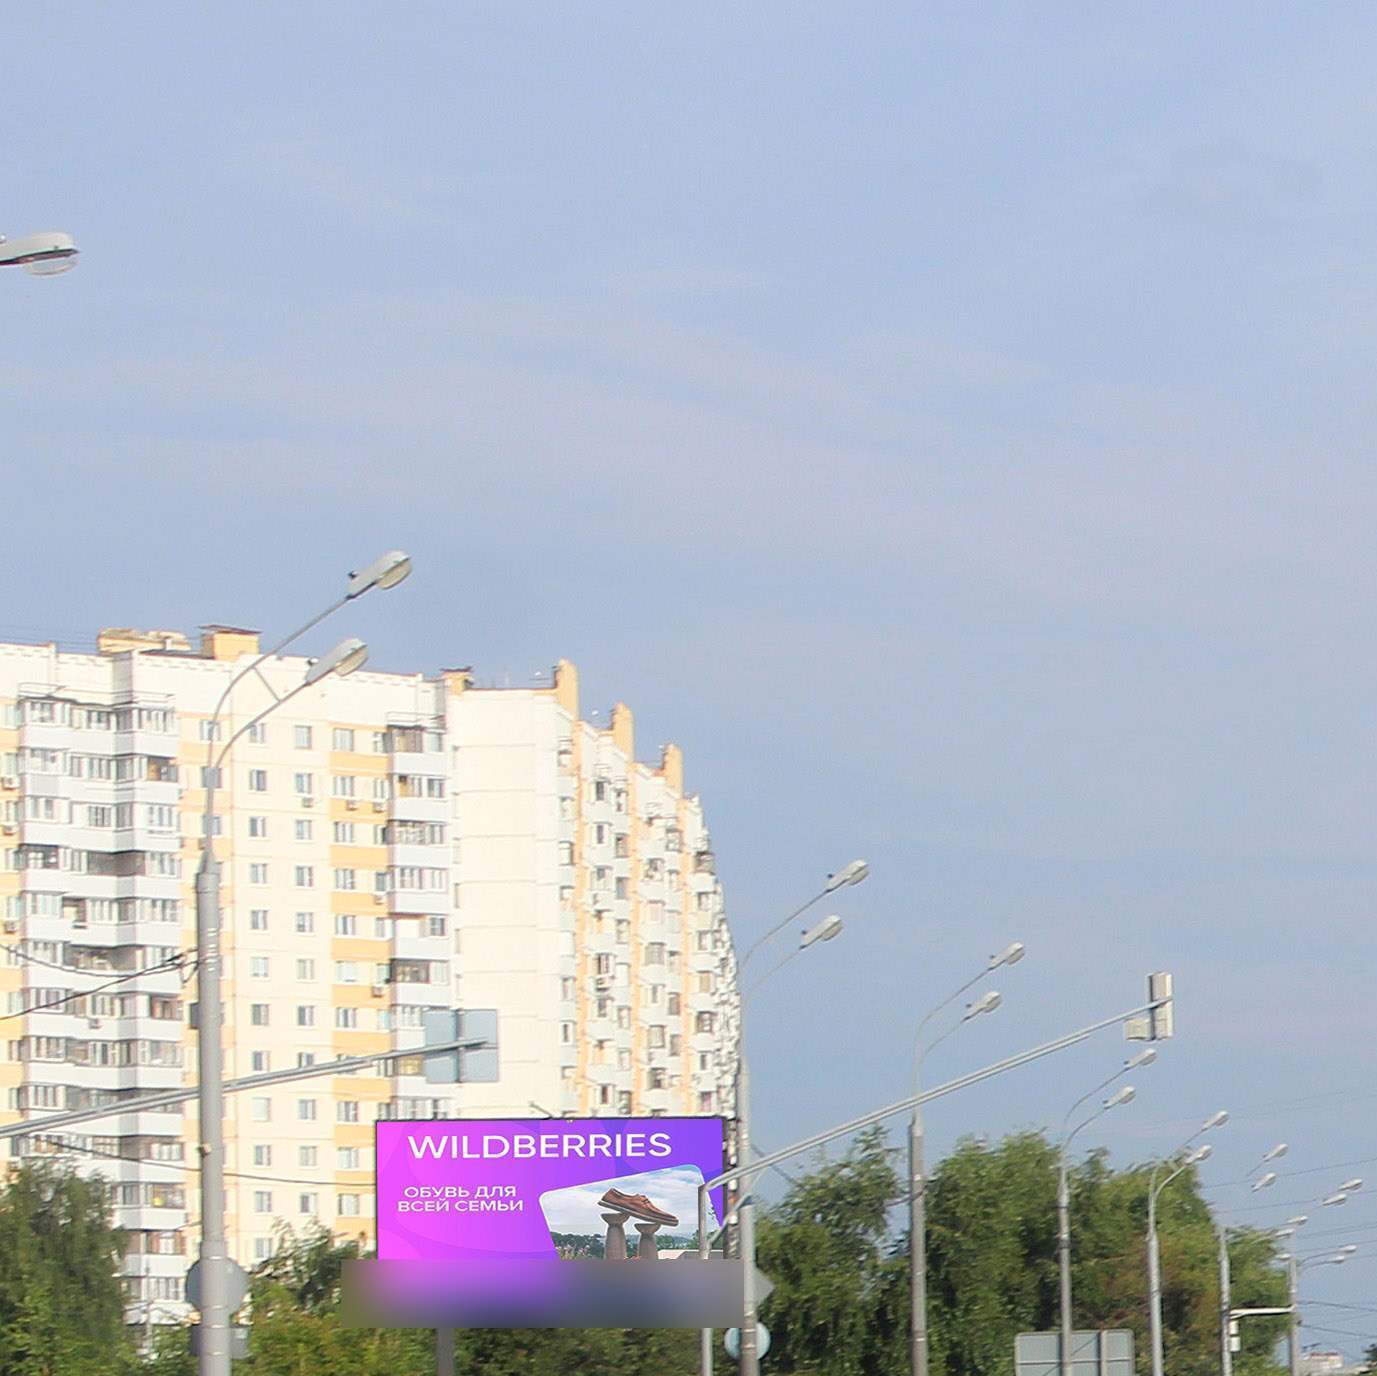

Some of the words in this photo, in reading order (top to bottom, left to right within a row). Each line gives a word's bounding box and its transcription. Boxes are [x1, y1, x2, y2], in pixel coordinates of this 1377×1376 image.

[407, 1132, 672, 1159] WILDBERRIES
[403, 1186, 470, 1198] ОБУВЬ
[474, 1185, 517, 1199] ДЛЯ
[397, 1197, 450, 1212] ВСЕЙ
[454, 1199, 524, 1211] СЕМЬИ
